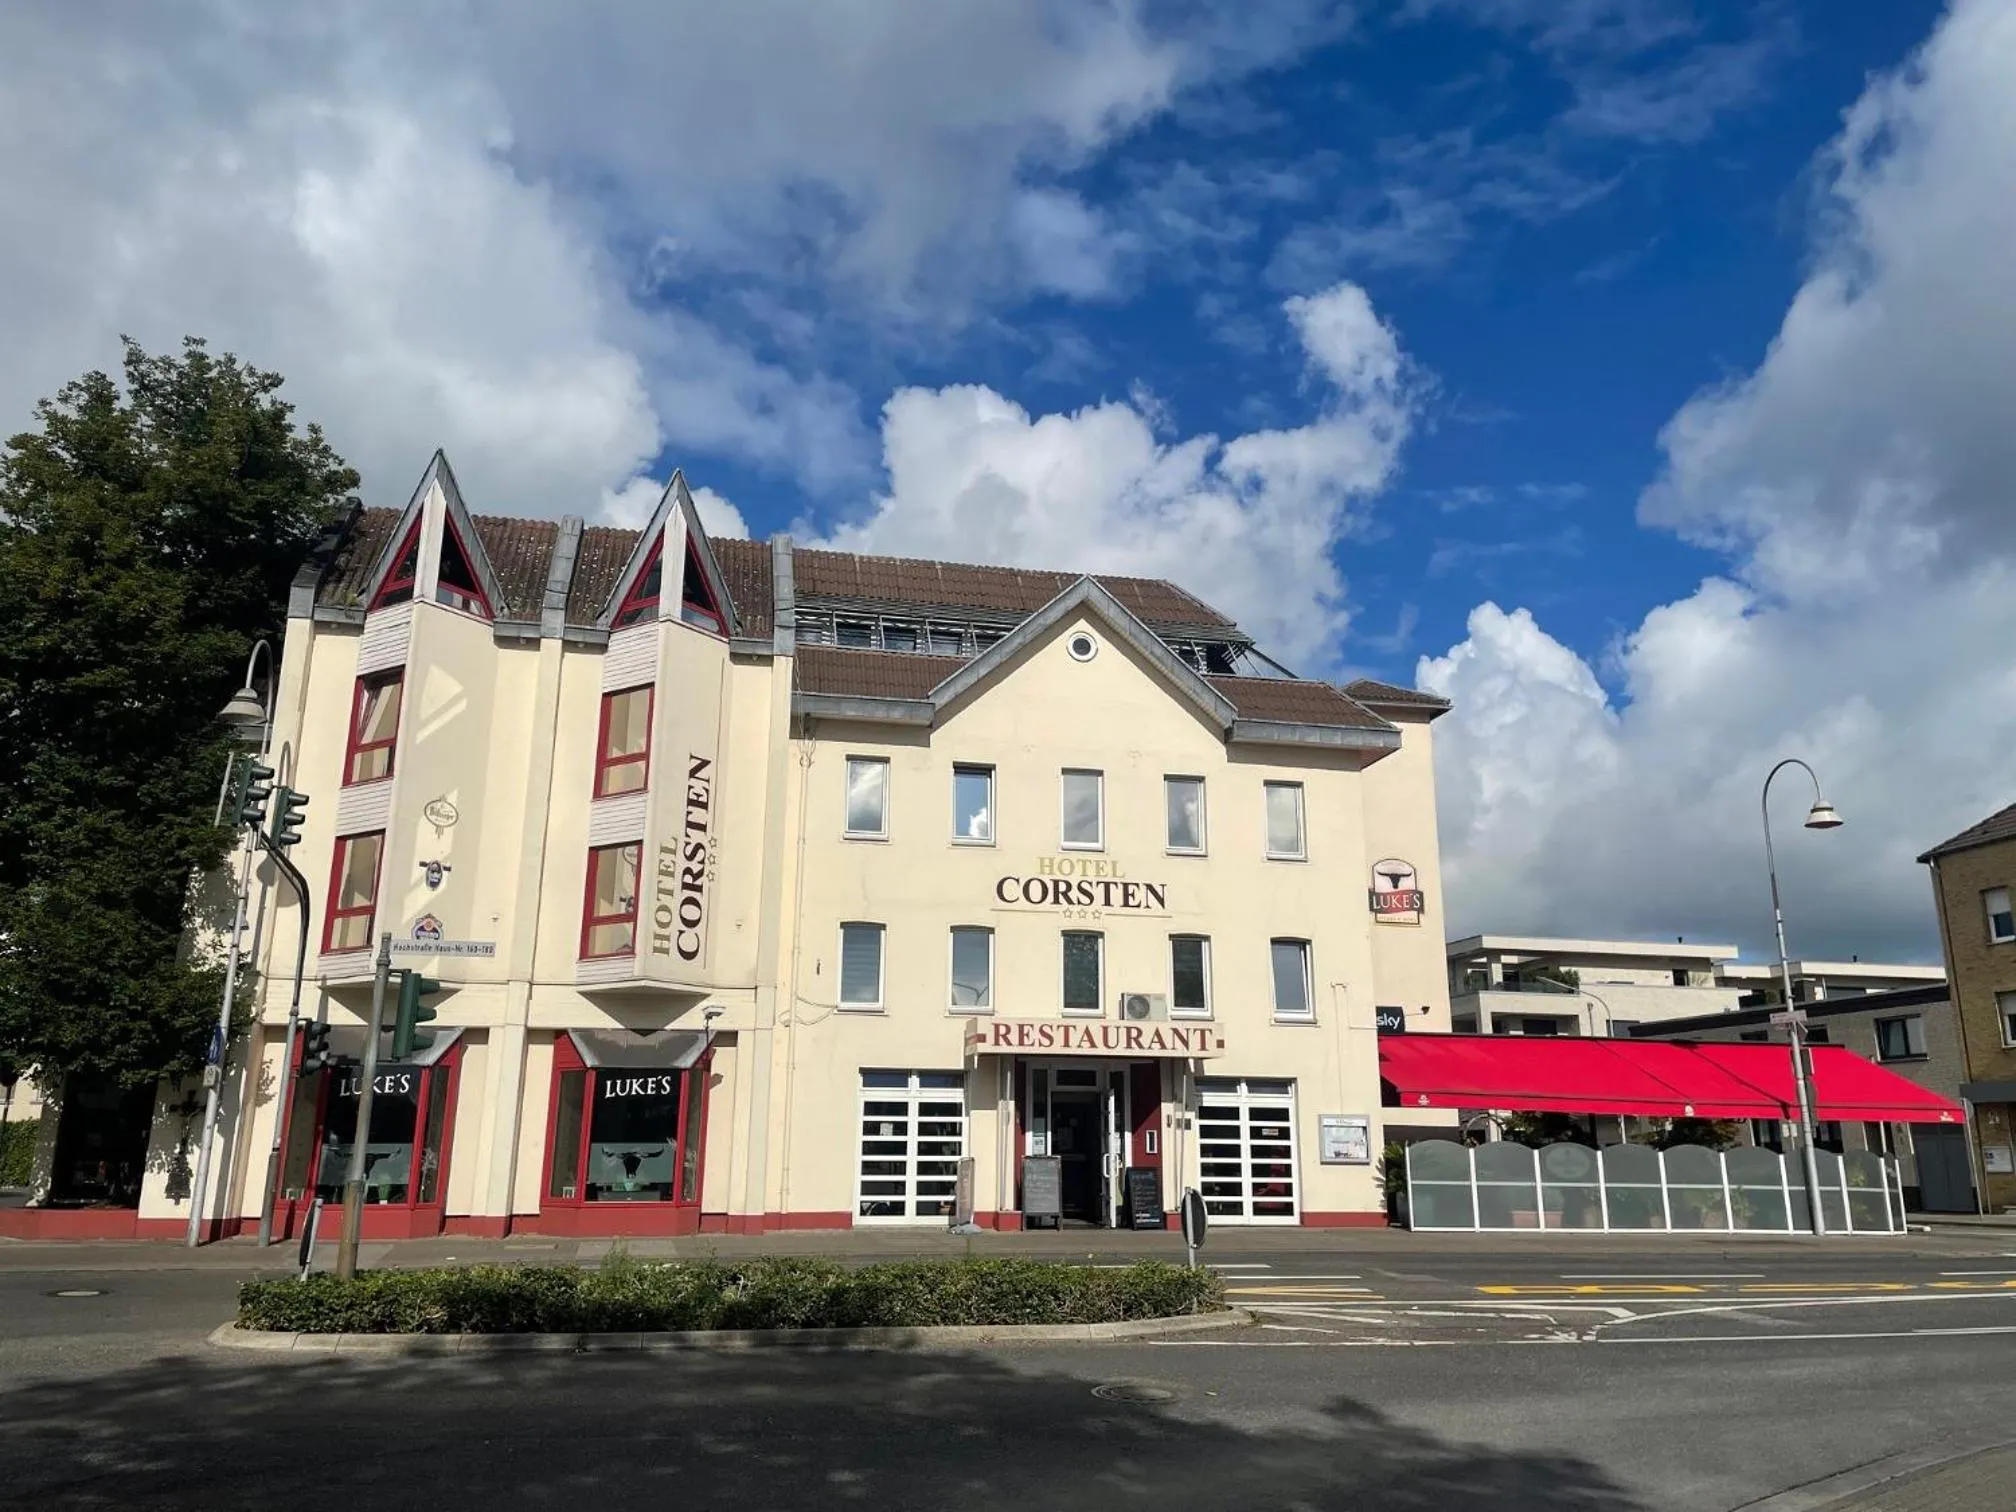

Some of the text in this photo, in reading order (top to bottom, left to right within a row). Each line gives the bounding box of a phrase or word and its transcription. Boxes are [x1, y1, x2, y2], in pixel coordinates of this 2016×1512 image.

[676, 752, 712, 961] CORSTEN
[1037, 856, 1126, 878] HOTEL
[652, 836, 678, 957] HOTEL
[996, 876, 1168, 909] CORSTEN
[1377, 1013, 1400, 1029] sky
[991, 1022, 1213, 1052] RESTAURANT
